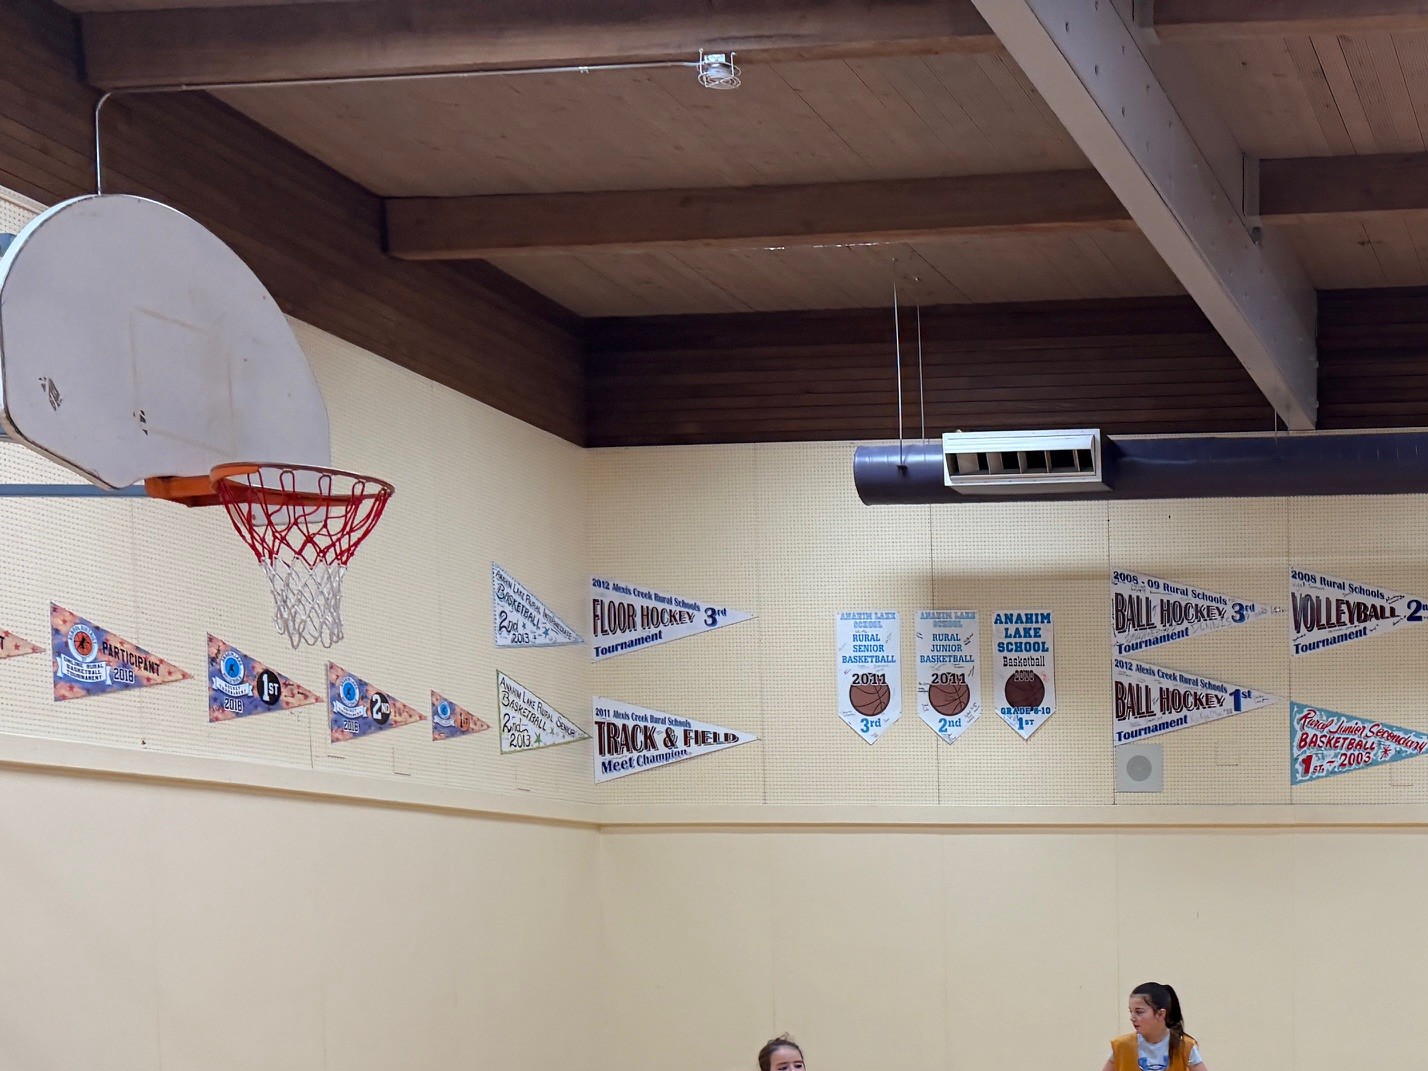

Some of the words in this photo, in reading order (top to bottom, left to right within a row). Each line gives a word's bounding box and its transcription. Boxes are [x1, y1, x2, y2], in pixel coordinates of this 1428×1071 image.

[592, 578, 610, 590] 2012
[612, 583, 632, 595] Alexis
[633, 588, 653, 600] Creek
[654, 593, 673, 605] Rural
[674, 598, 701, 611] Schools
[1113, 571, 1138, 585] 2008
[1147, 580, 1160, 589] 09
[1163, 583, 1188, 597] Rural
[1191, 590, 1228, 605] Schools
[1291, 569, 1317, 584] 2008
[1320, 576, 1346, 591] Rural
[1349, 584, 1385, 600] Schools
[496, 583, 540, 629] BASKETBALL
[592, 599, 637, 637] FLOOR
[641, 605, 695, 630] HOCKEY
[704, 607, 727, 627] 3rd
[1114, 592, 1157, 634] BALL
[1160, 598, 1227, 627] HOCKEY
[1231, 602, 1255, 623] 3rd
[1291, 592, 1400, 633] VOLLEYBALL
[499, 610, 519, 634] 2nd
[994, 613, 1051, 624] ANAHIM
[511, 633, 530, 643] 2013
[594, 630, 663, 657] Tournament
[853, 634, 880, 642] RURAL
[1005, 628, 1041, 638] LAKE
[1116, 627, 1189, 655] Tournament
[1293, 626, 1368, 654] Tournament
[102, 641, 160, 676] PARTICIPANT
[842, 655, 896, 663] BASKETBALL
[920, 655, 974, 663] BASKETBALL
[998, 642, 1049, 653] SCHOOL
[1003, 656, 1045, 667] Basketball
[114, 668, 134, 683] 2018
[262, 673, 279, 702] 1ST
[852, 673, 887, 685] 2011
[931, 673, 966, 685] 2011
[1115, 659, 1133, 671] 2012
[1135, 664, 1156, 677] Alexis
[1157, 669, 1178, 682] Creek
[1179, 674, 1199, 686] Rural
[1200, 679, 1228, 693] Schools
[372, 694, 390, 720] 2ND
[502, 690, 546, 731] BASKETBALL
[1115, 681, 1156, 721] BALL
[1159, 686, 1226, 714] HOCKEY
[1229, 689, 1252, 712] 1st
[502, 713, 528, 733] 2nd
[596, 708, 610, 718] 2011
[613, 710, 630, 720] Alexis
[631, 712, 648, 722] Creek
[650, 715, 666, 725] Rural
[668, 717, 692, 728] Schools
[860, 718, 881, 733] 3rd
[938, 718, 961, 733] 2nd
[1018, 717, 1034, 730] 1ST
[1116, 715, 1188, 741] Tournament
[510, 733, 531, 748] 2013
[595, 721, 659, 757] TRACK
[663, 727, 678, 749] &
[683, 729, 739, 747] FIELD
[1298, 732, 1376, 750] BASKETBALL
[1299, 710, 1334, 731] Rural
[1329, 721, 1366, 736] Junior
[1365, 723, 1428, 753] Secondary
[602, 757, 636, 774] Meet
[636, 749, 688, 766] Champion
[1339, 752, 1371, 768] 2003
